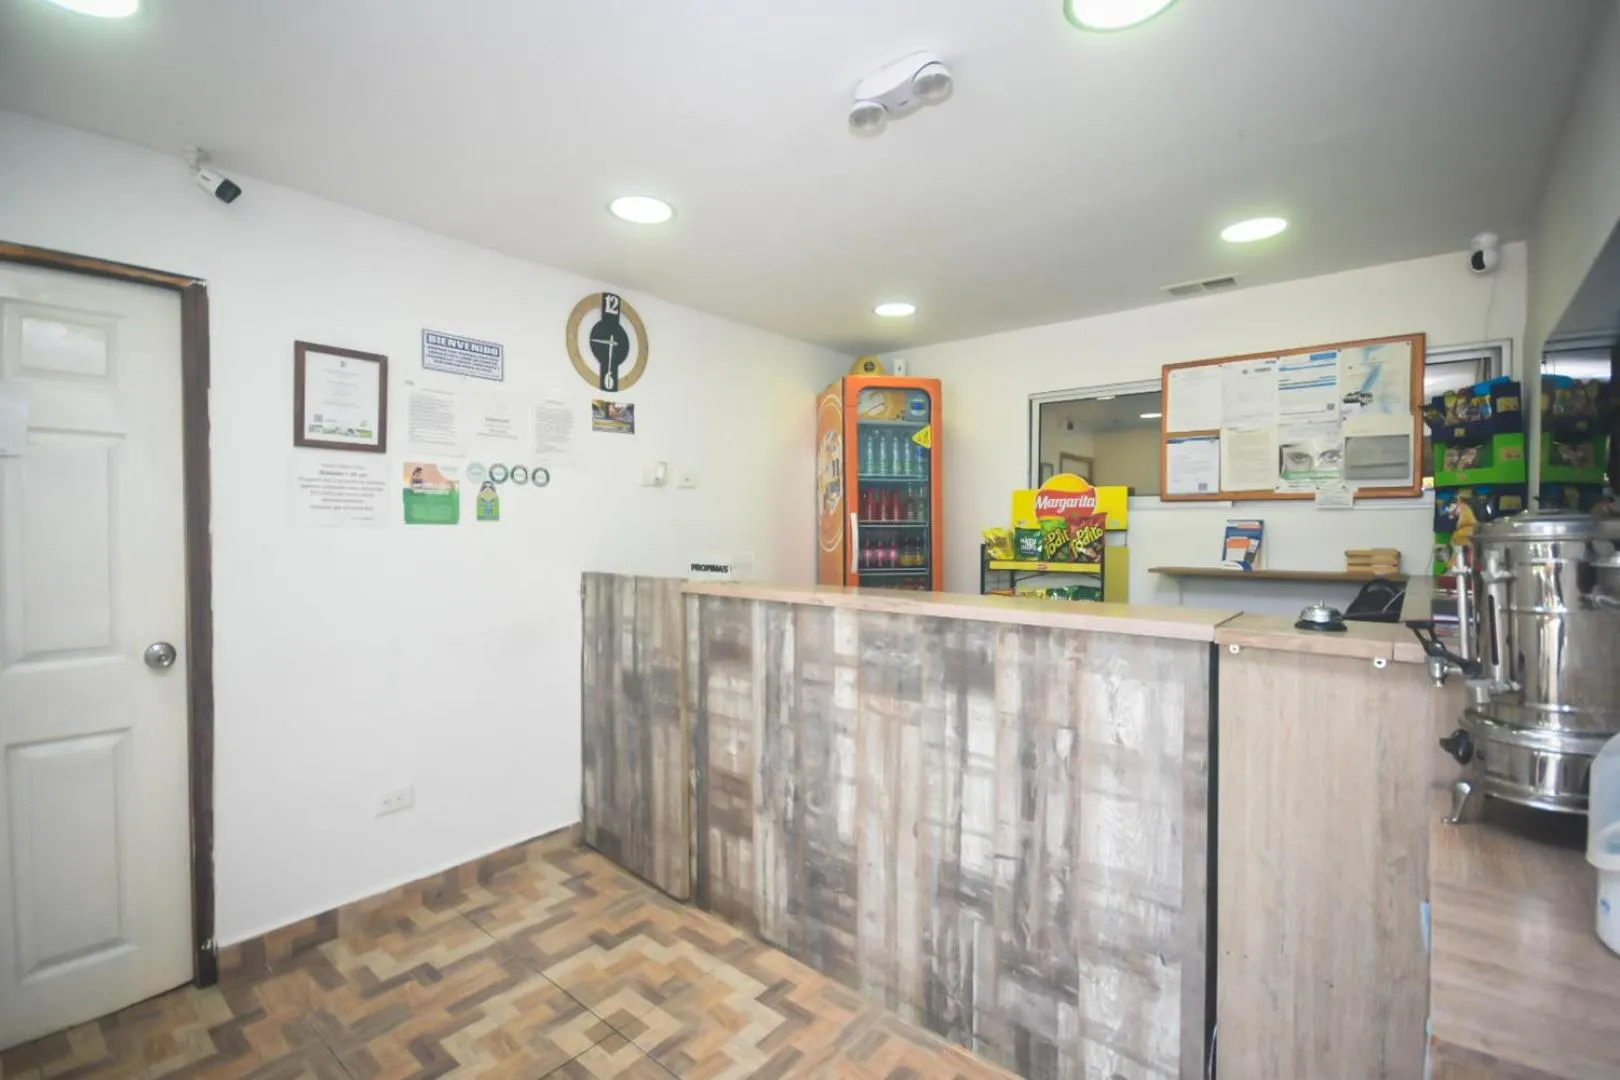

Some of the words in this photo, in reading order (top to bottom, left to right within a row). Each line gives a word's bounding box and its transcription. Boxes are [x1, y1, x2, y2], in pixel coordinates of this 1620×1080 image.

[604, 294, 619, 315] 12
[428, 334, 498, 356] BIENVENIDO
[603, 372, 614, 390] 6
[1035, 495, 1096, 513] Margarita
